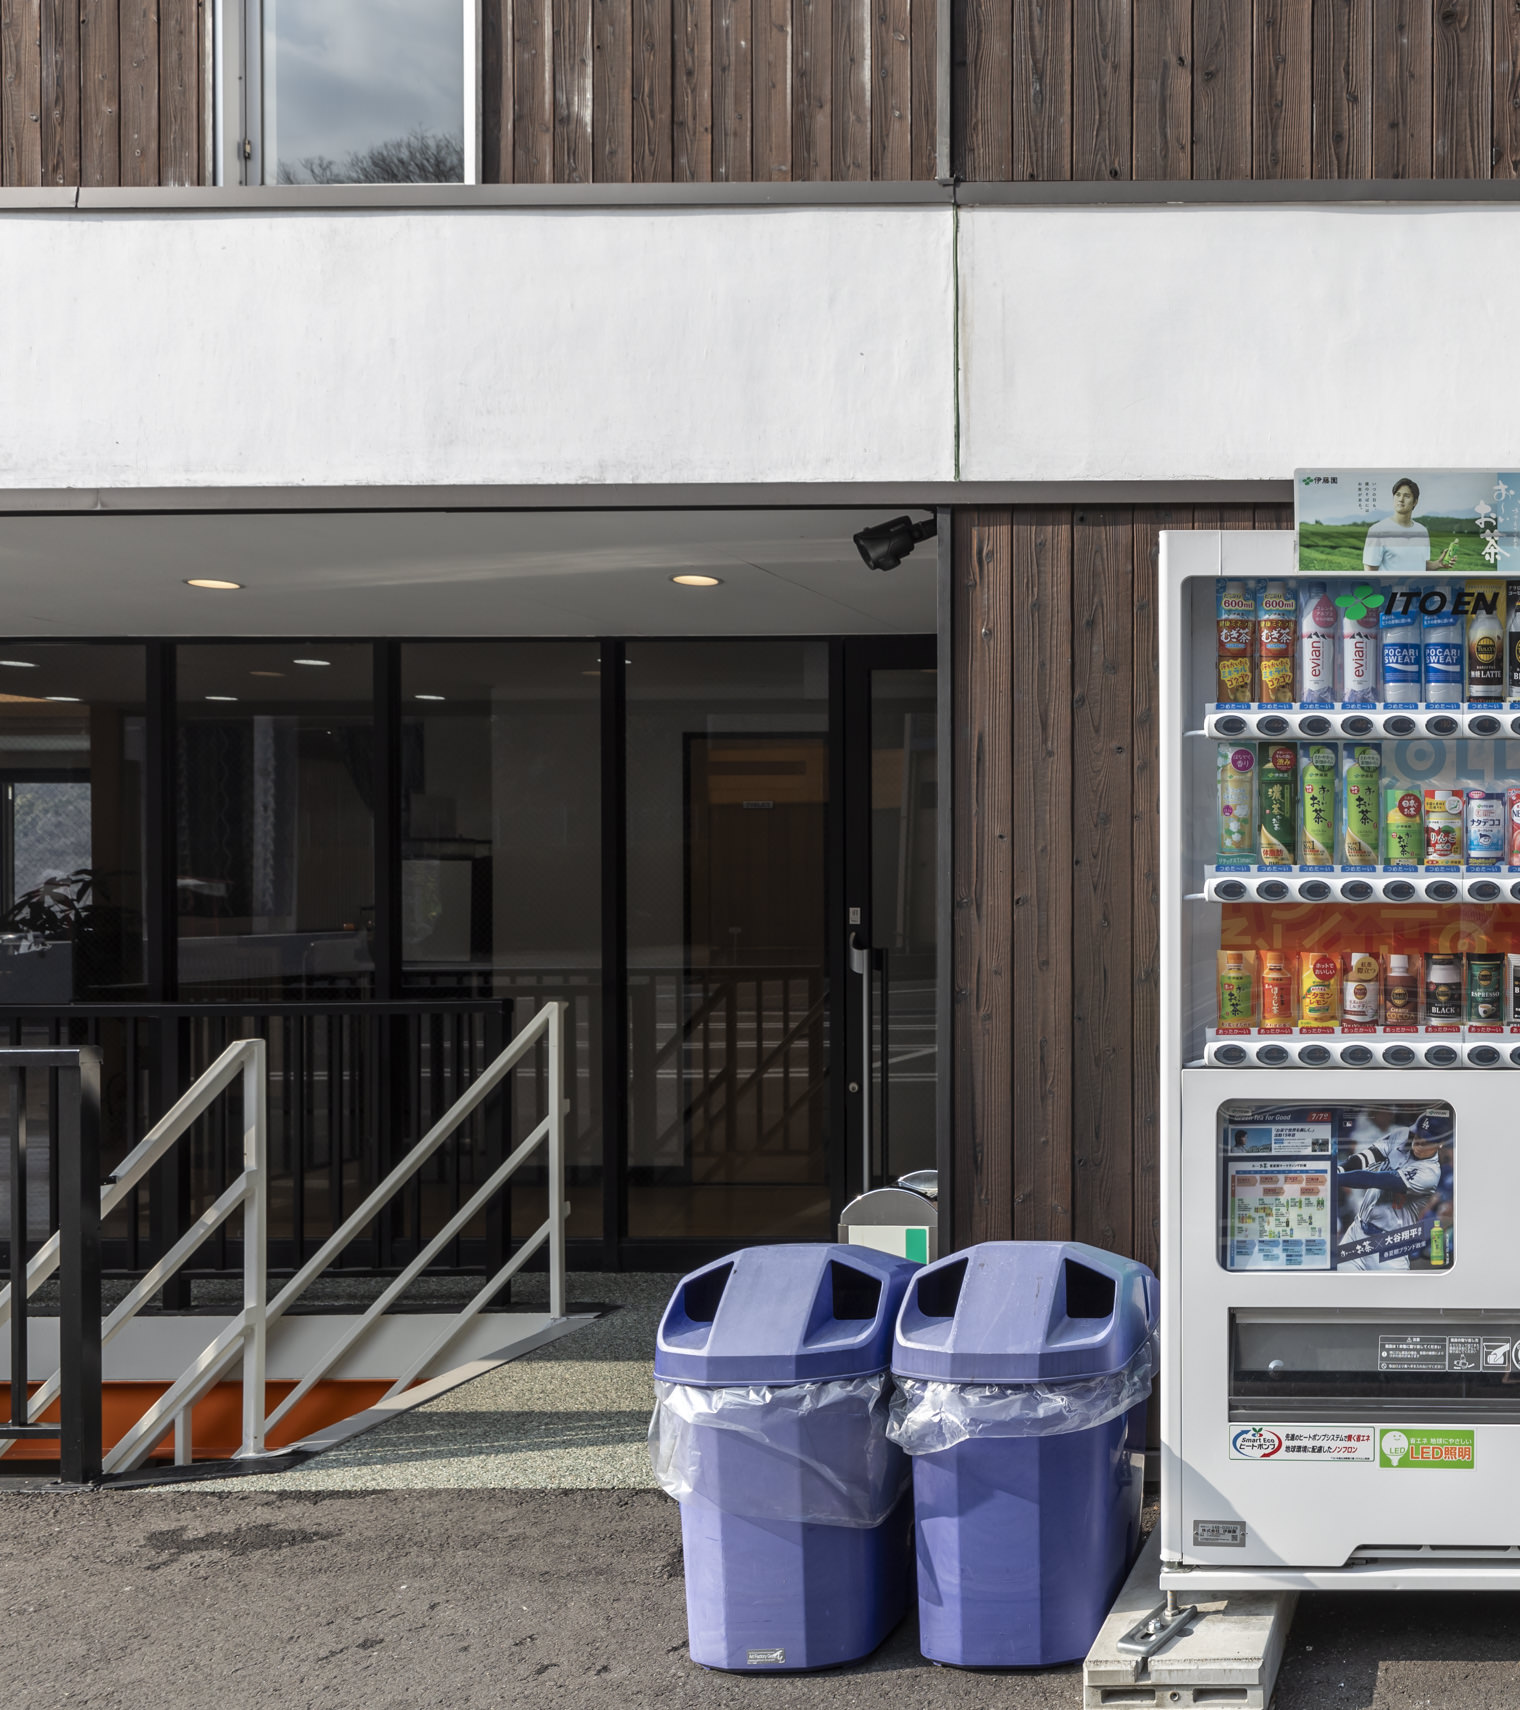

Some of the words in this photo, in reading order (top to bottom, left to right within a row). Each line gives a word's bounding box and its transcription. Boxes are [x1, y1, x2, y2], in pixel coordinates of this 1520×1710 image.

[1224, 599, 1253, 609] 600ml
[1265, 599, 1294, 609] 600ml
[1385, 591, 1448, 615] ITO
[1451, 591, 1500, 615] EN
[1220, 628, 1251, 643] むぎ茶
[1261, 628, 1292, 643] むぎ茶
[1384, 648, 1419, 656] POCARI
[1426, 648, 1461, 656] POCARI
[1309, 640, 1321, 677] evian
[1352, 641, 1365, 678] evian
[1384, 656, 1415, 664] SWEAT
[1426, 656, 1457, 664] SWEAT
[1470, 819, 1501, 827] ナタデココ
[1430, 832, 1457, 843] りんご
[1431, 1006, 1455, 1014] BLACK
[1384, 1228, 1418, 1246] 大谷翔平
[1430, 1437, 1472, 1445] 地球にやさしい
[1409, 1445, 1472, 1461] LED照明
